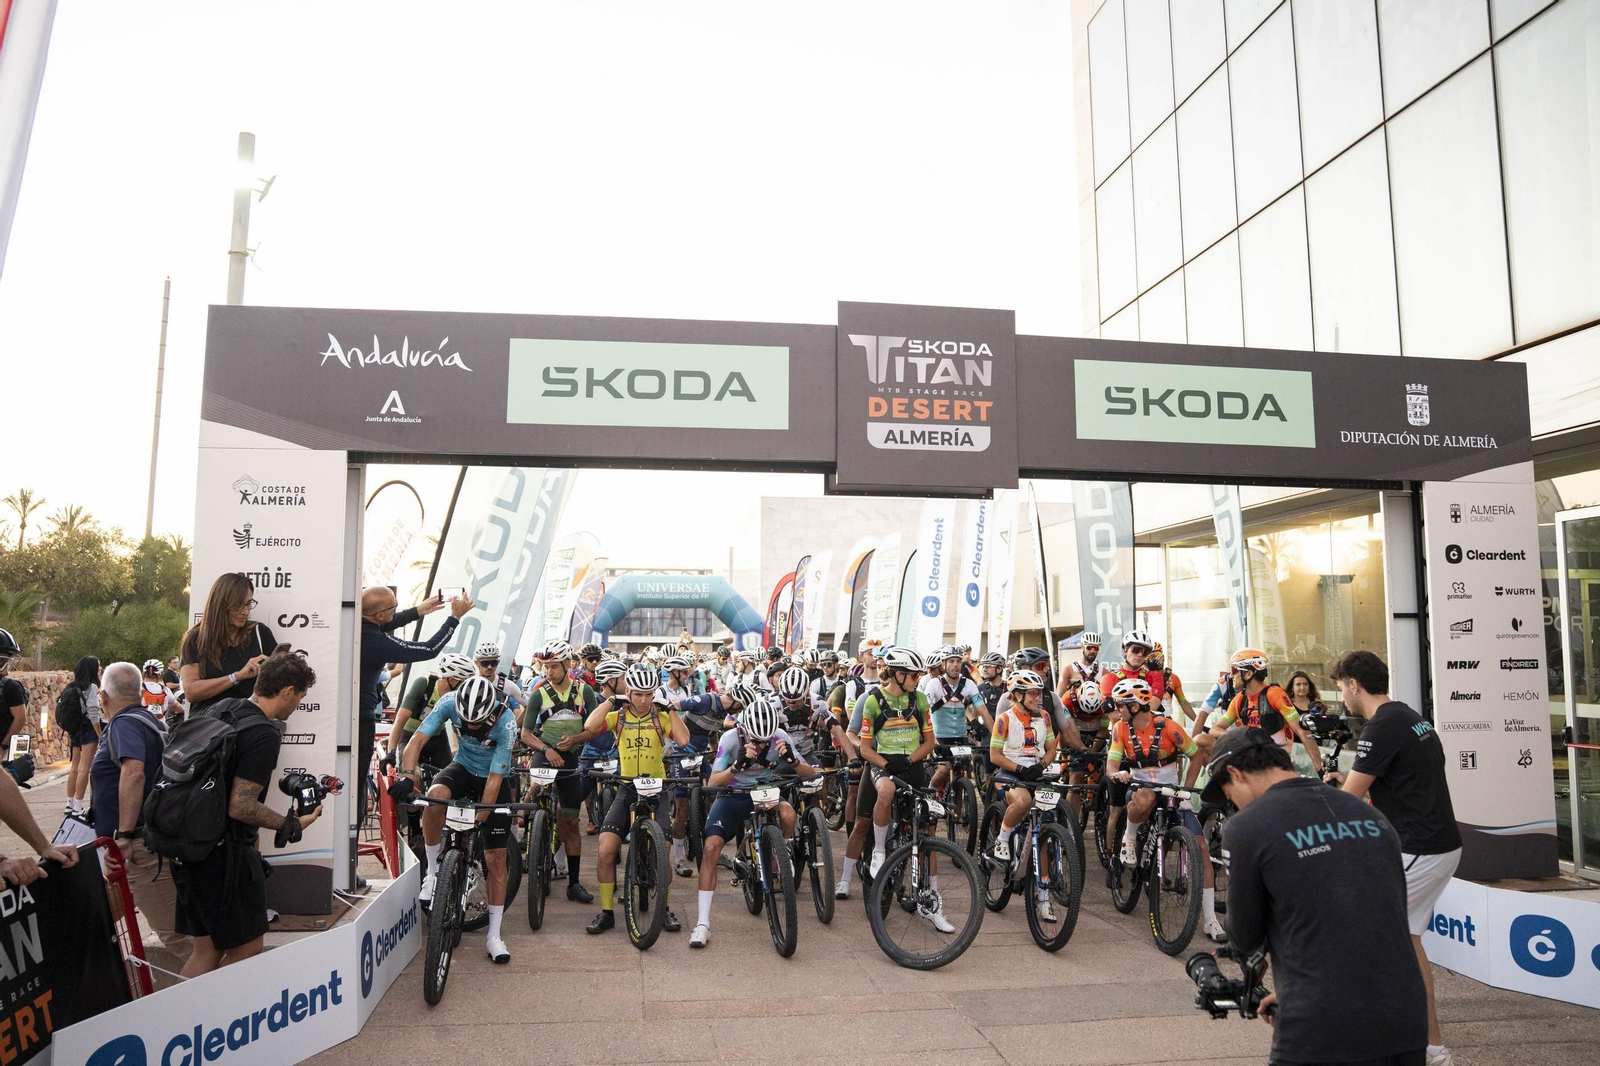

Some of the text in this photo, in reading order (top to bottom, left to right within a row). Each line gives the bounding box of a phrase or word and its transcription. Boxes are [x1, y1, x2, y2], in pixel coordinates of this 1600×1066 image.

[320, 332, 473, 372] Andalucía
[909, 388, 946, 396] STAGE
[868, 396, 994, 422] DESERT
[884, 428, 974, 447] ALMERÍA
[1340, 429, 1498, 449] DIPUTACIÓN DE ALMERÍA
[252, 494, 306, 506] ALMERÍA
[1470, 504, 1515, 515] ALMERÍA
[256, 536, 301, 547] EJÉRCITO
[929, 517, 944, 592] Cleardent
[1466, 550, 1526, 560] Cleardent
[238, 567, 292, 588] ETO DE
[637, 582, 710, 593] UNIVERSAE
[1447, 661, 1480, 669] MRW
[1450, 691, 1481, 701] Almería
[1469, 753, 1476, 768] 1
[762, 790, 768, 798] 3
[1040, 791, 1054, 800] 203
[1286, 820, 1382, 849] WHATS
[1298, 844, 1331, 858] STUDIOS
[375, 902, 417, 967] Cleardent
[10, 977, 41, 1003] RACE
[162, 969, 343, 1066] Cleardent
